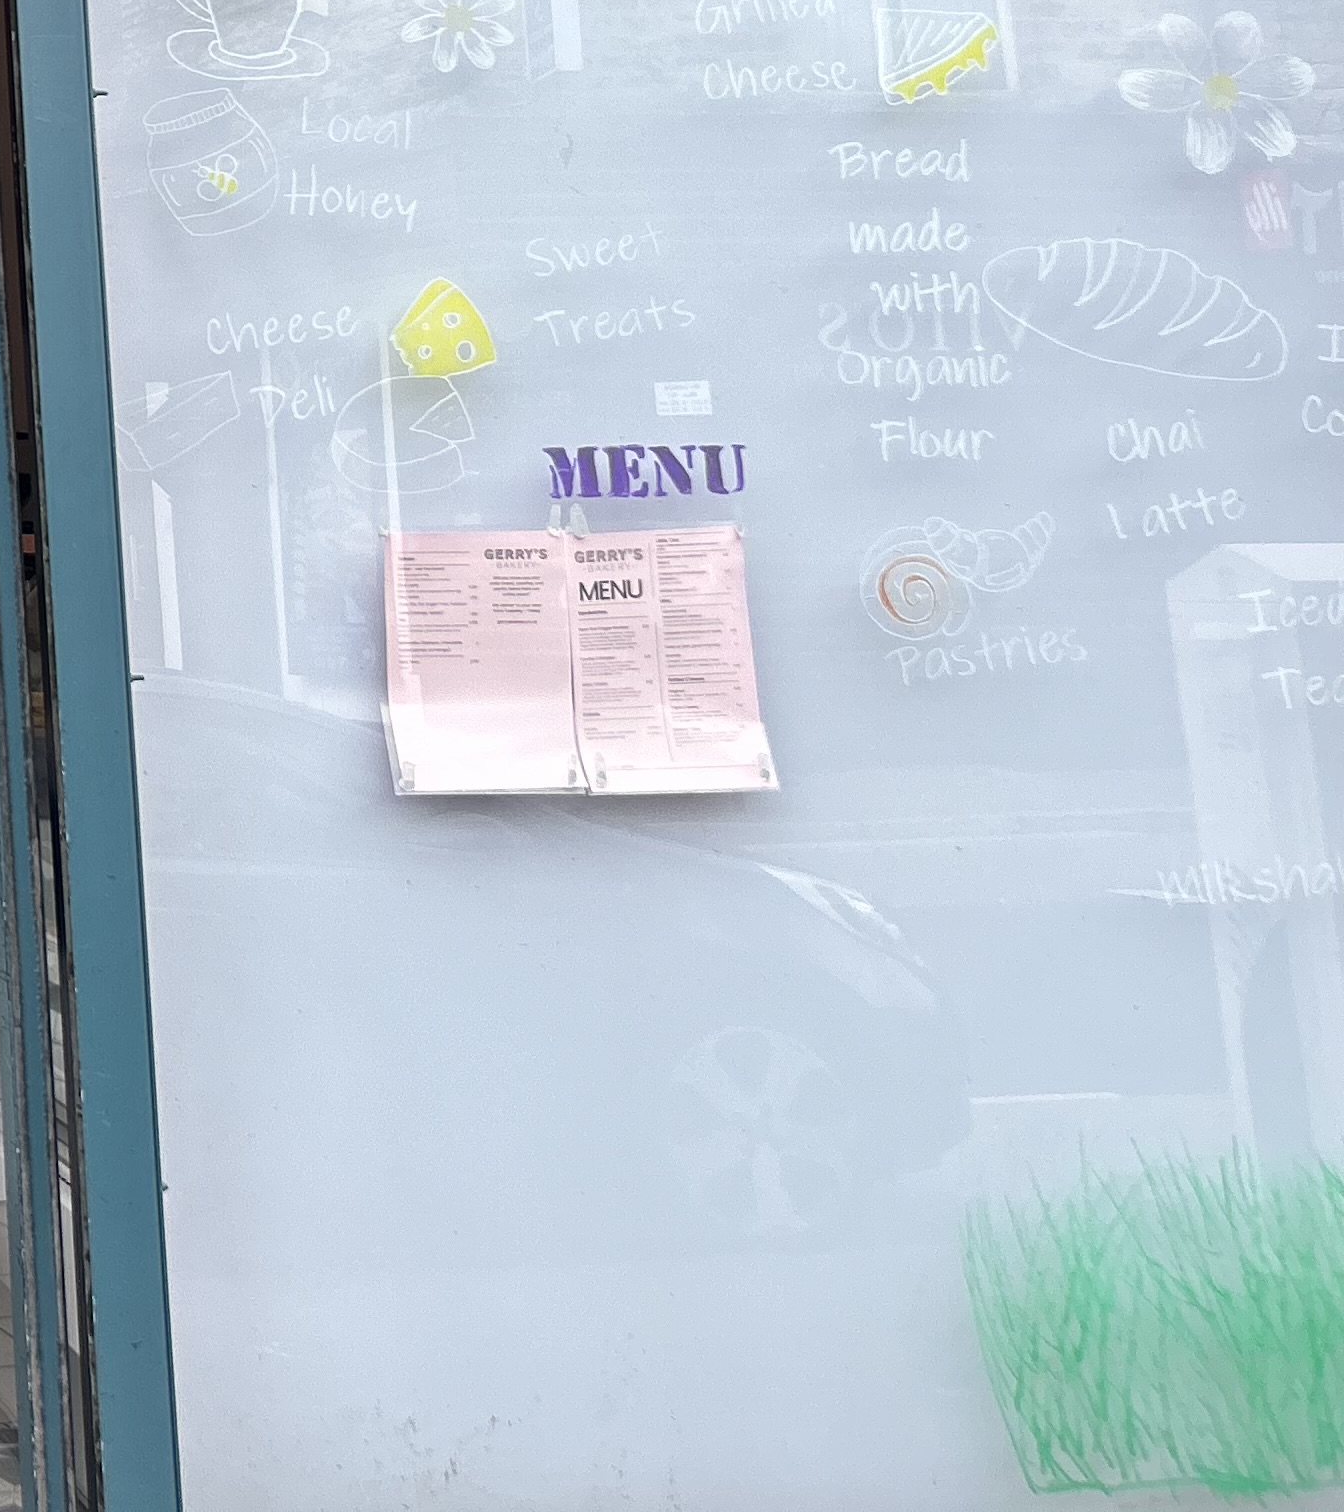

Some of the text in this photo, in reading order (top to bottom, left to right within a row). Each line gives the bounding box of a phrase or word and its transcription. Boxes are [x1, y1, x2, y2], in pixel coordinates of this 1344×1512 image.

[301, 97, 412, 150] Local
[826, 139, 972, 183] Bread
[284, 165, 417, 232] Honey
[525, 223, 664, 277] Sweet
[848, 207, 971, 254] made
[870, 272, 981, 315] with
[533, 296, 697, 348] Treats
[837, 345, 1012, 401] Organic
[249, 374, 337, 428] Deli
[870, 416, 994, 464] Flour
[1106, 408, 1205, 464] Chai
[542, 443, 747, 499] MENU
[483, 548, 549, 561] GERRY'S
[574, 548, 643, 563] GERRY'S
[578, 579, 643, 601] MENU
[884, 627, 1089, 686] Pastries
[1157, 854, 1344, 906] milksha
